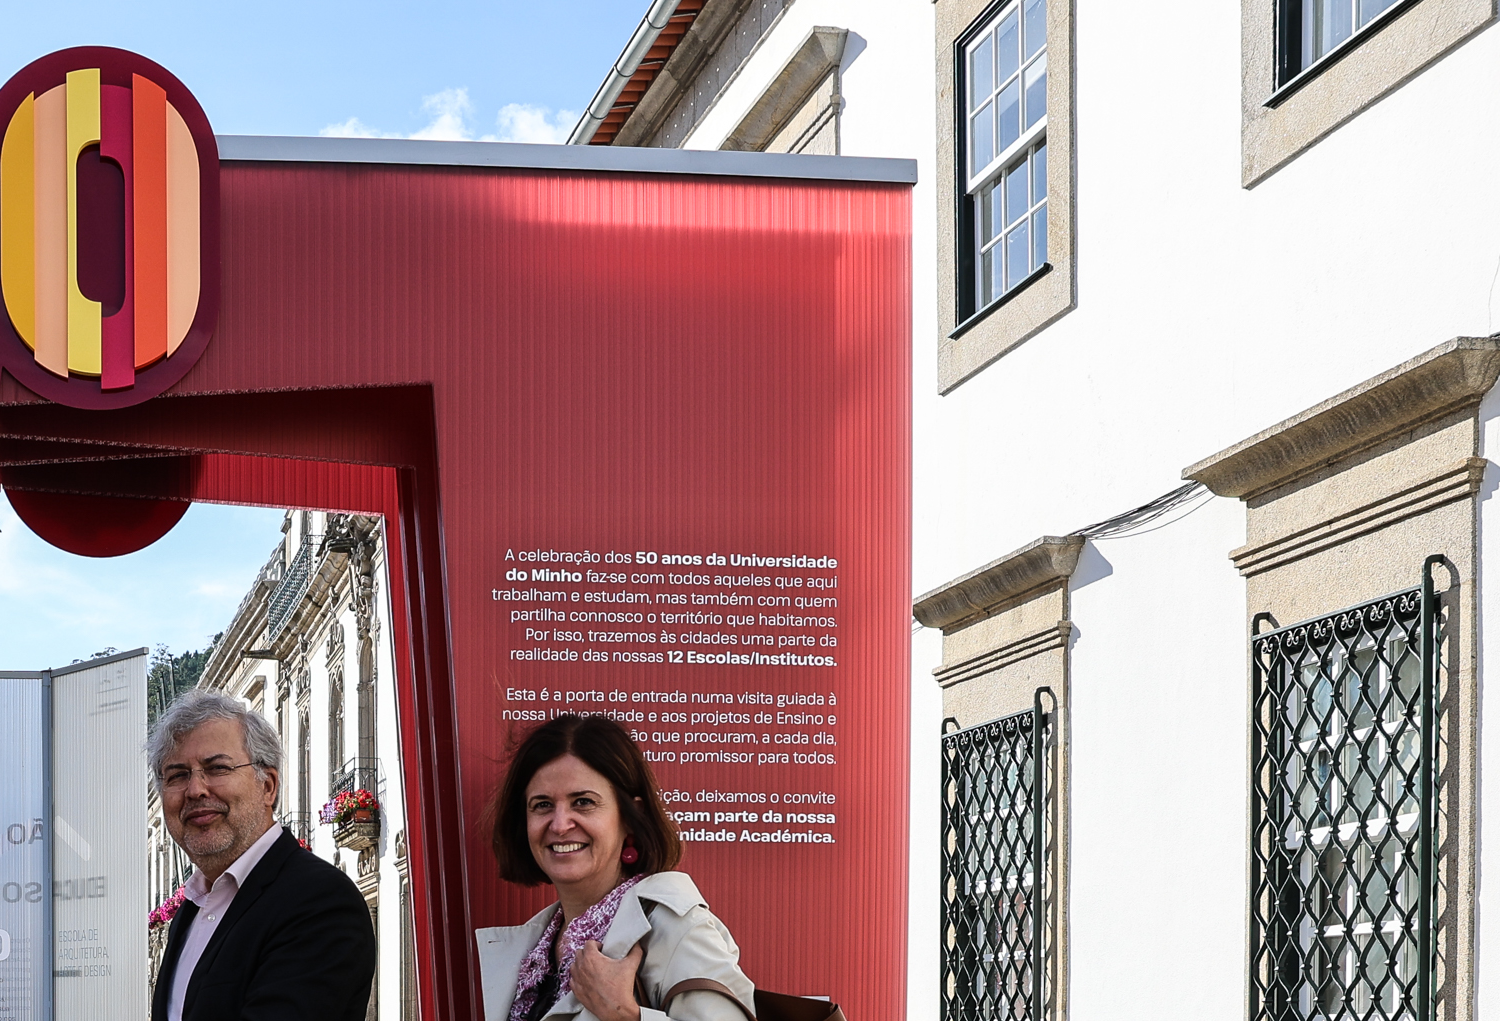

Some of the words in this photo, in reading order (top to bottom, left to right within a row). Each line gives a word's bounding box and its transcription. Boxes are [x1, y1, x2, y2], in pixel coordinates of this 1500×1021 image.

[504, 548, 515, 561] A
[518, 549, 600, 566] celebração
[604, 550, 632, 564] dos
[635, 551, 658, 565] 50
[661, 554, 702, 566] anos
[705, 553, 727, 567] da
[730, 553, 838, 568] Universidade
[505, 568, 528, 581] do
[531, 568, 582, 582] Minho
[586, 569, 627, 584] faz-se
[631, 573, 664, 584] com
[668, 572, 710, 586] todos
[713, 573, 771, 588] aqueles
[774, 576, 803, 589] que
[806, 576, 838, 590] aqui
[491, 587, 567, 601] trabalham
[570, 591, 580, 602] e
[584, 590, 652, 605] estudam,
[655, 593, 687, 604] mas
[690, 592, 753, 606] também
[757, 595, 790, 606] com
[794, 596, 838, 610] quem
[510, 608, 566, 623] partilha
[569, 611, 643, 623] connosco
[647, 613, 657, 623] o
[660, 610, 723, 625] território
[726, 614, 755, 627] que
[758, 613, 838, 627] habitamos.
[525, 628, 550, 641] Por
[553, 628, 585, 643] isso,
[588, 630, 656, 643] trazemos
[660, 630, 677, 644] às
[680, 631, 738, 645] cidades
[741, 634, 774, 645] uma
[778, 635, 815, 648] parte
[819, 634, 838, 647] da
[510, 647, 578, 661] realidade
[582, 648, 608, 662] das
[612, 651, 664, 663] nossas
[667, 650, 684, 663] 12
[687, 650, 838, 667] Escolas/Institutos.
[506, 688, 536, 701] Esta
[540, 687, 549, 701] é
[553, 691, 562, 701] a
[566, 689, 605, 704] porta
[608, 689, 627, 702] de
[631, 690, 687, 704] entrada
[691, 693, 733, 704] numa
[736, 692, 773, 705] visita
[776, 692, 825, 708] guiada
[828, 692, 837, 706] à
[502, 709, 546, 720] nossa
[648, 712, 657, 722] e
[661, 711, 687, 723] aos
[691, 710, 750, 726] projetos
[754, 711, 772, 724] de
[776, 711, 824, 725] Ensino
[827, 715, 837, 725] e
[652, 732, 680, 745] que
[684, 732, 759, 745] procuram,
[762, 733, 770, 744] a
[774, 731, 809, 744] cada
[812, 732, 837, 746] dia,
[680, 750, 755, 764] promissor
[758, 752, 789, 766] para
[793, 751, 837, 765] todos.
[696, 789, 767, 804] deixamos
[770, 793, 779, 804] o
[783, 791, 836, 804] convite
[663, 808, 711, 825] açam
[714, 810, 758, 825] parte
[762, 810, 783, 824] da
[786, 813, 836, 824] nossa
[677, 828, 736, 842] nidade
[739, 829, 836, 843] Académica.
[58, 929, 87, 943] ESCOLA
[88, 928, 98, 941] DE
[84, 964, 111, 977] DESIGN
